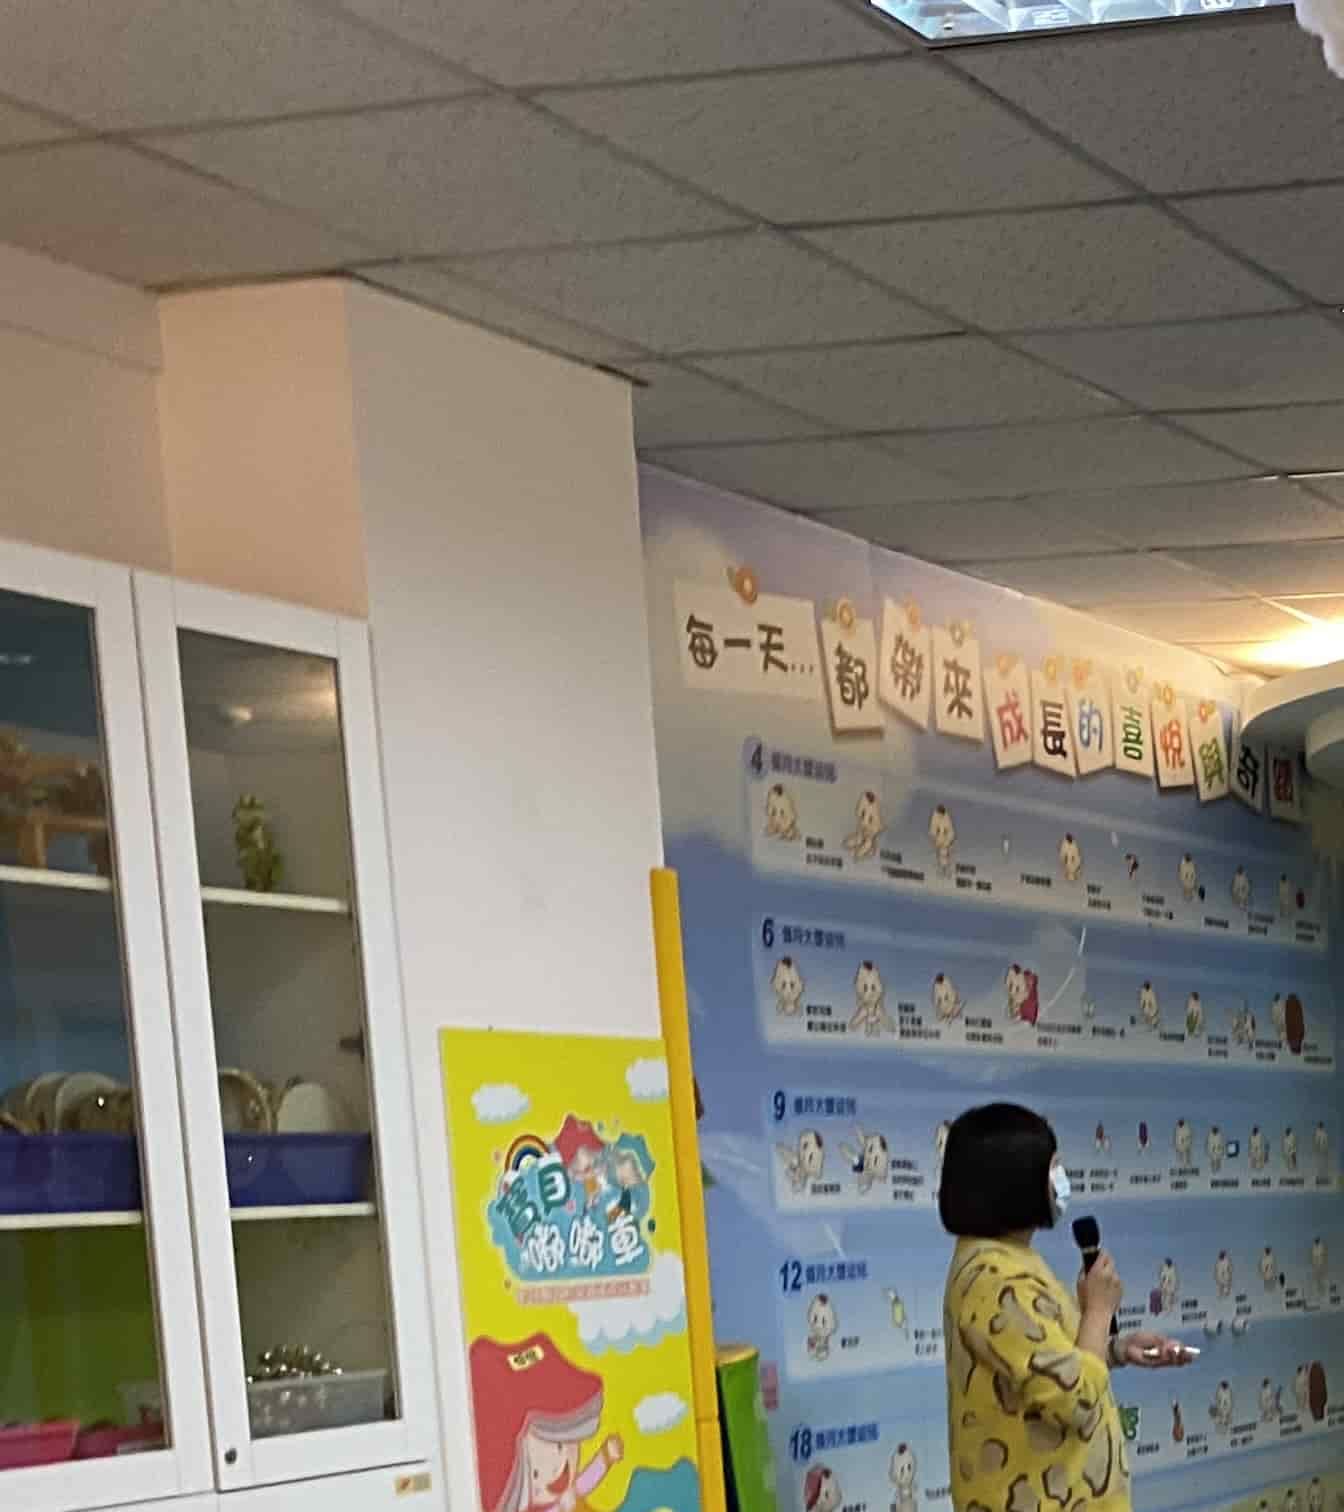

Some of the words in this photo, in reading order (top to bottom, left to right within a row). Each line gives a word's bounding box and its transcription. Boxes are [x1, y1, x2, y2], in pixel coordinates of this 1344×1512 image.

[762, 917, 774, 949] 6
[774, 1090, 786, 1121] 9
[779, 1260, 803, 1292] 12
[790, 1429, 812, 1462] 18
